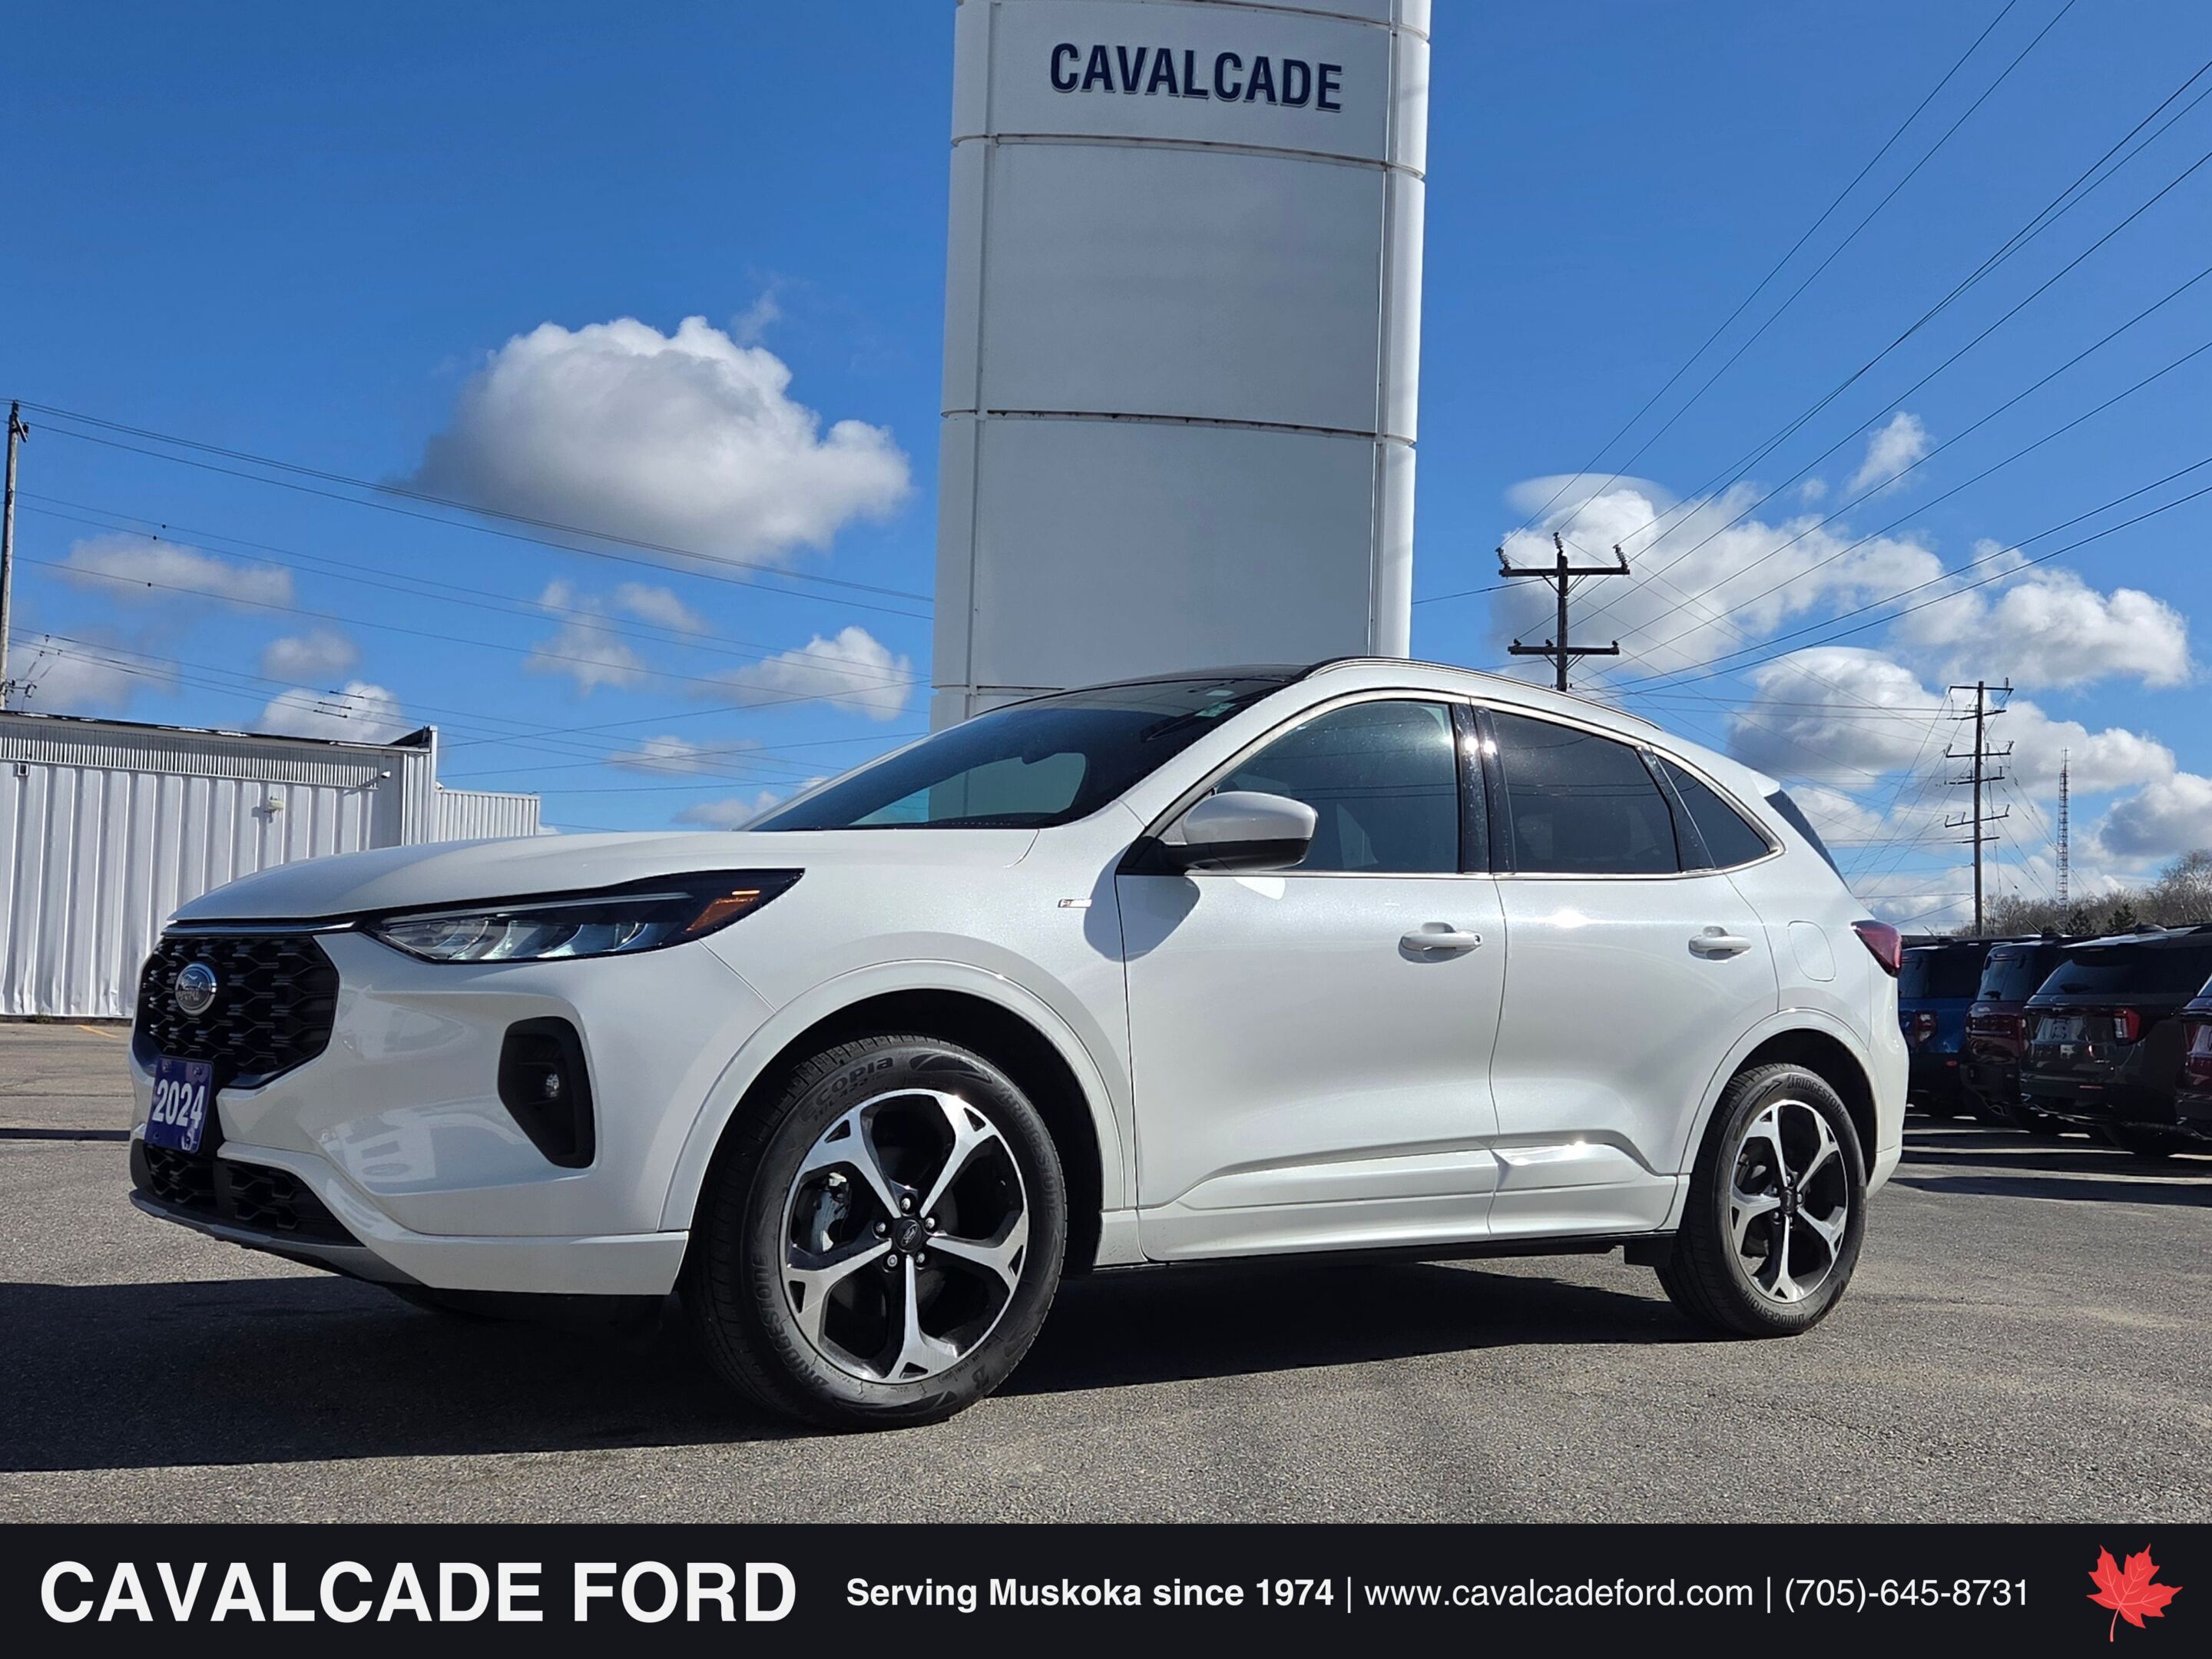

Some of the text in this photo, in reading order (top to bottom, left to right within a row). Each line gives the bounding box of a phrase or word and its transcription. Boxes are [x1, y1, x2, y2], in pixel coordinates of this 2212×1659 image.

[1050, 41, 1342, 112] CAVALCADE
[151, 1079, 206, 1130] 2024
[1786, 1074, 1847, 1119] BRIDGESTONE
[752, 1253, 830, 1388] BRIDGESTONE
[1740, 1288, 1805, 1326] BRIDGESTONE
